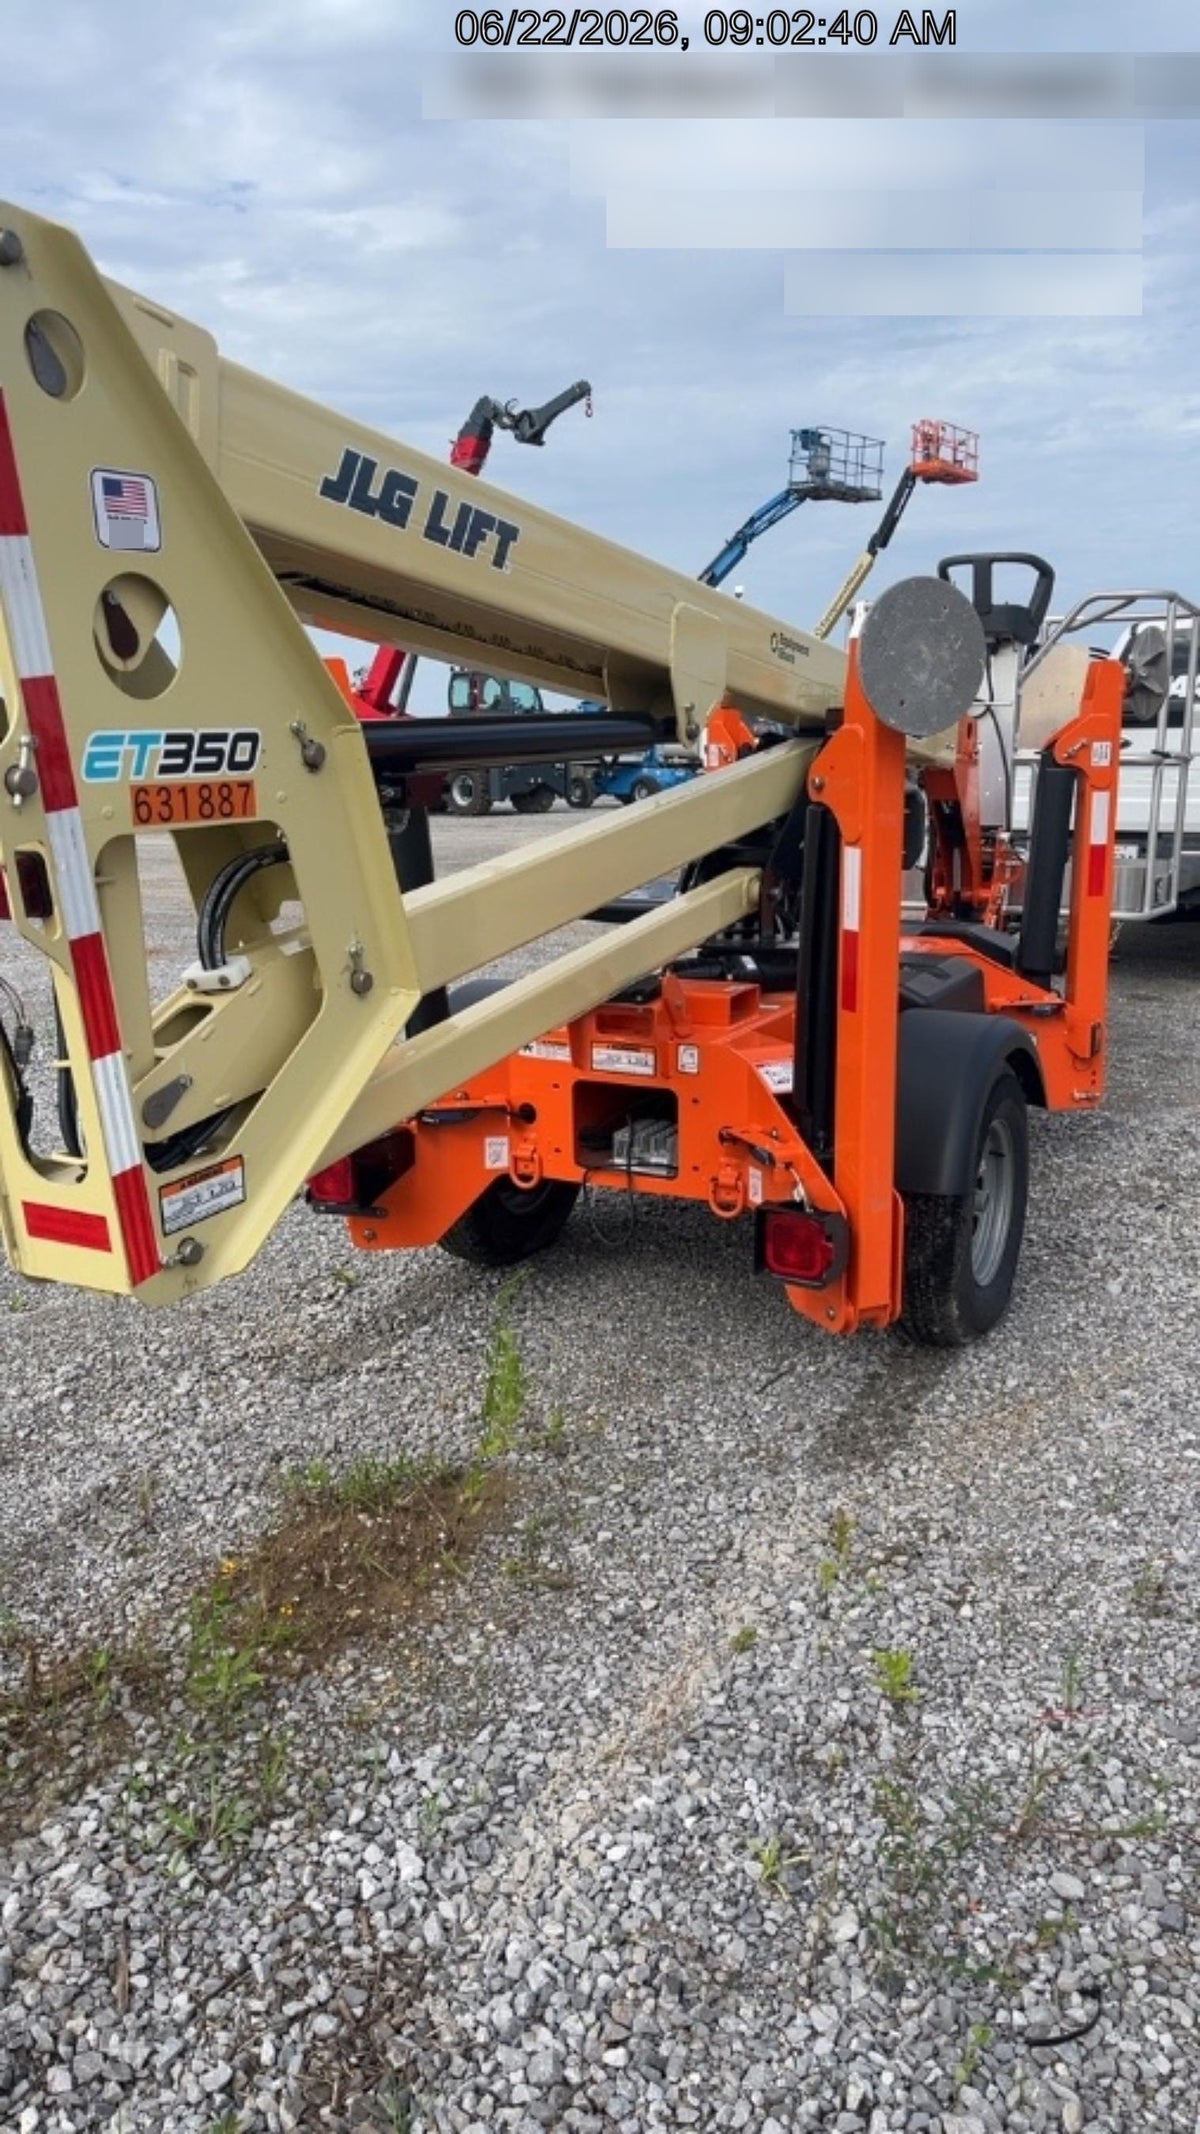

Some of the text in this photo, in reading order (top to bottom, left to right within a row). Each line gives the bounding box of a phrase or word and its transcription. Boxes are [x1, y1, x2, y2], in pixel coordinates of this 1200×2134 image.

[319, 447, 520, 570] JLG LIFT
[83, 729, 260, 781] ET350
[135, 781, 251, 824] 631887
